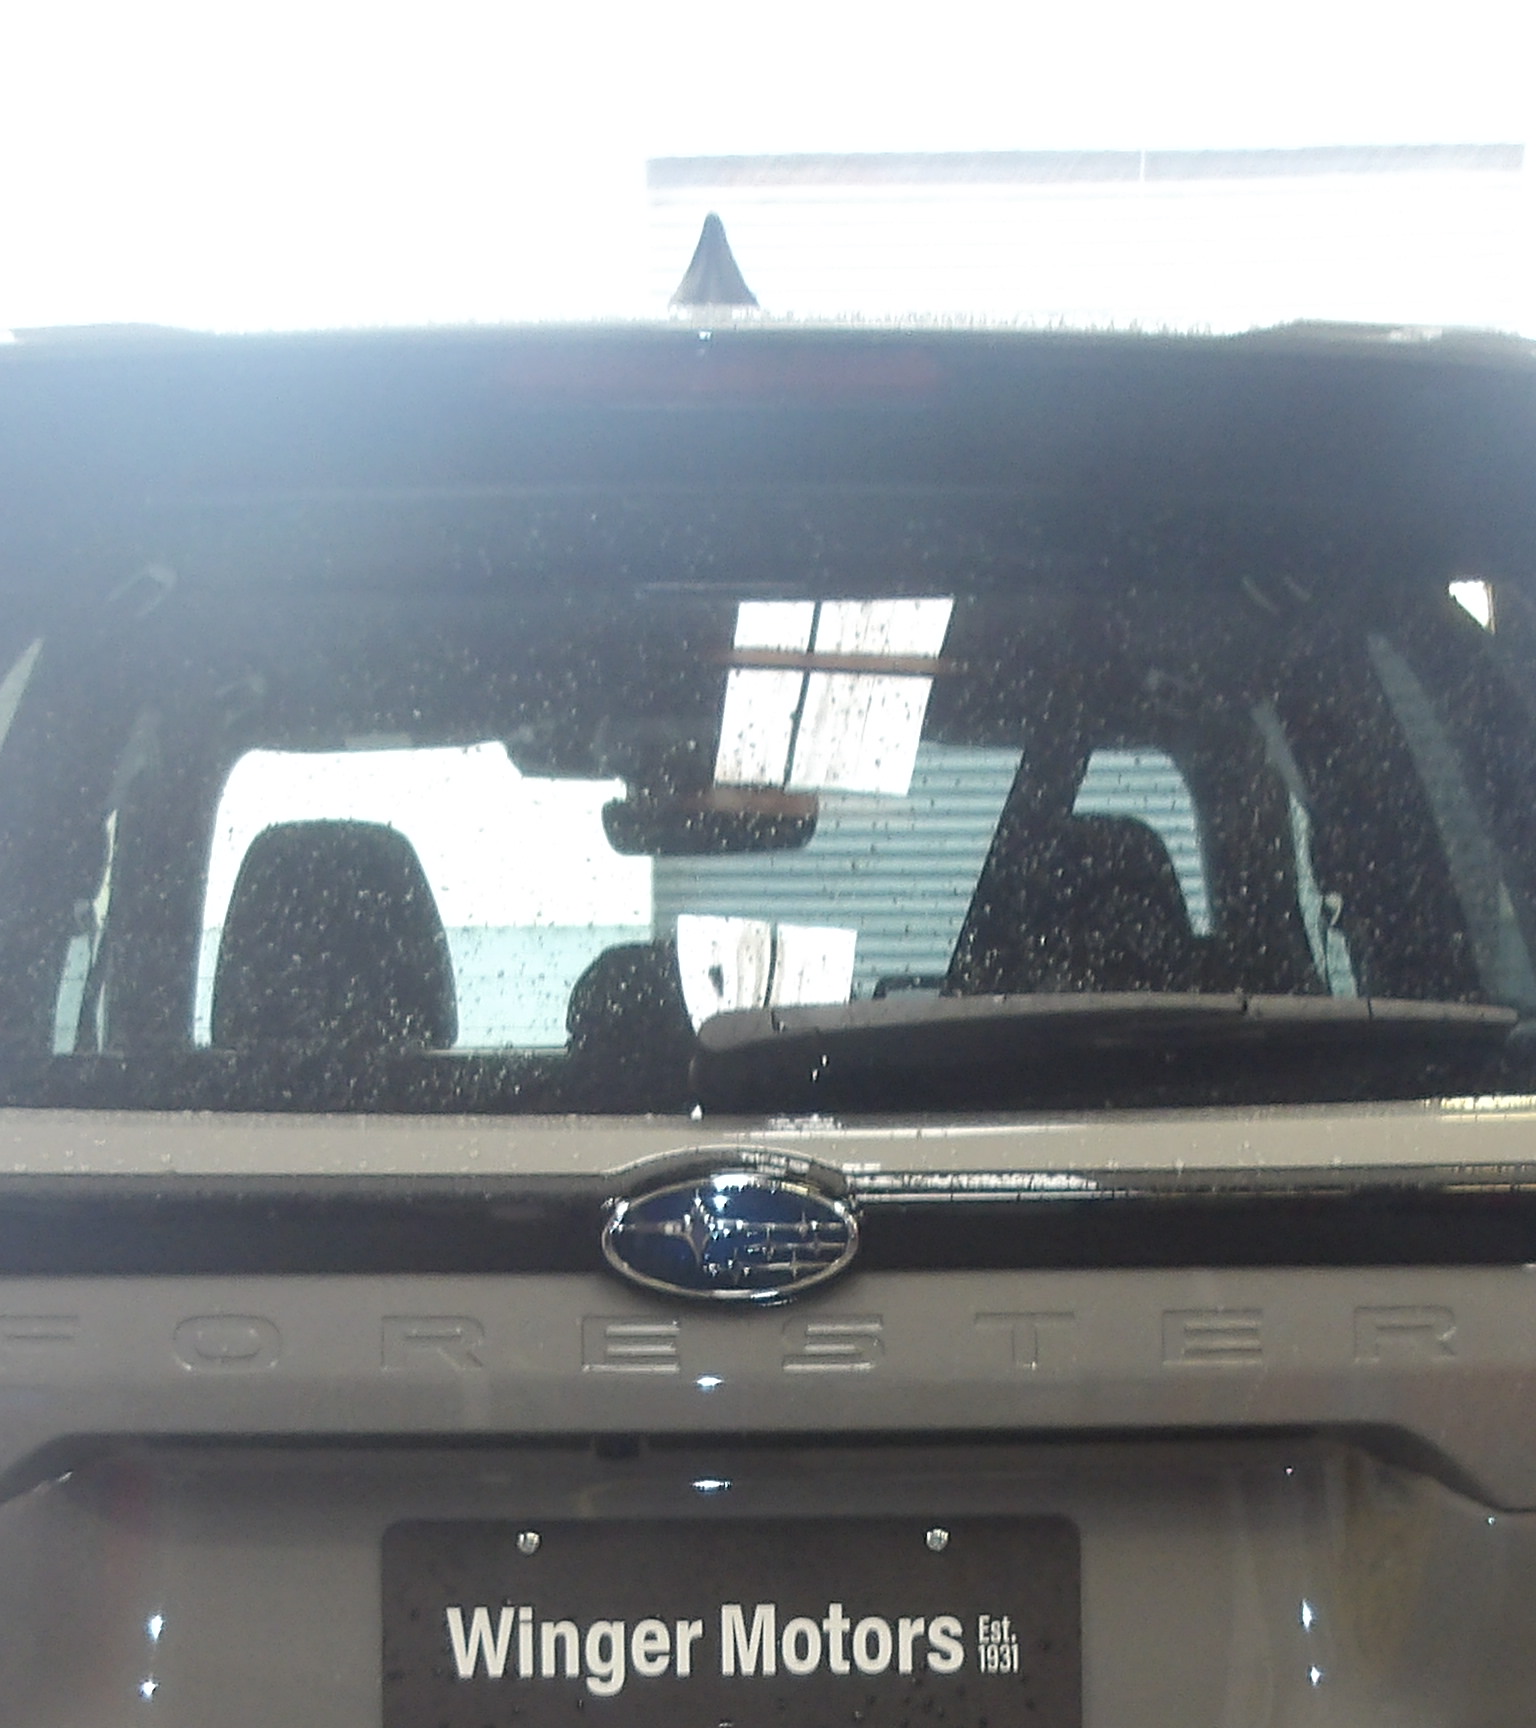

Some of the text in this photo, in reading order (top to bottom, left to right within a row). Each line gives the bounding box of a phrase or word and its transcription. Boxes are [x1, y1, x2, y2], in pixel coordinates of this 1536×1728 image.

[977, 1614, 1018, 1644] Est.
[445, 1602, 966, 1698] Winger Motors
[977, 1643, 1020, 1675] 1931
